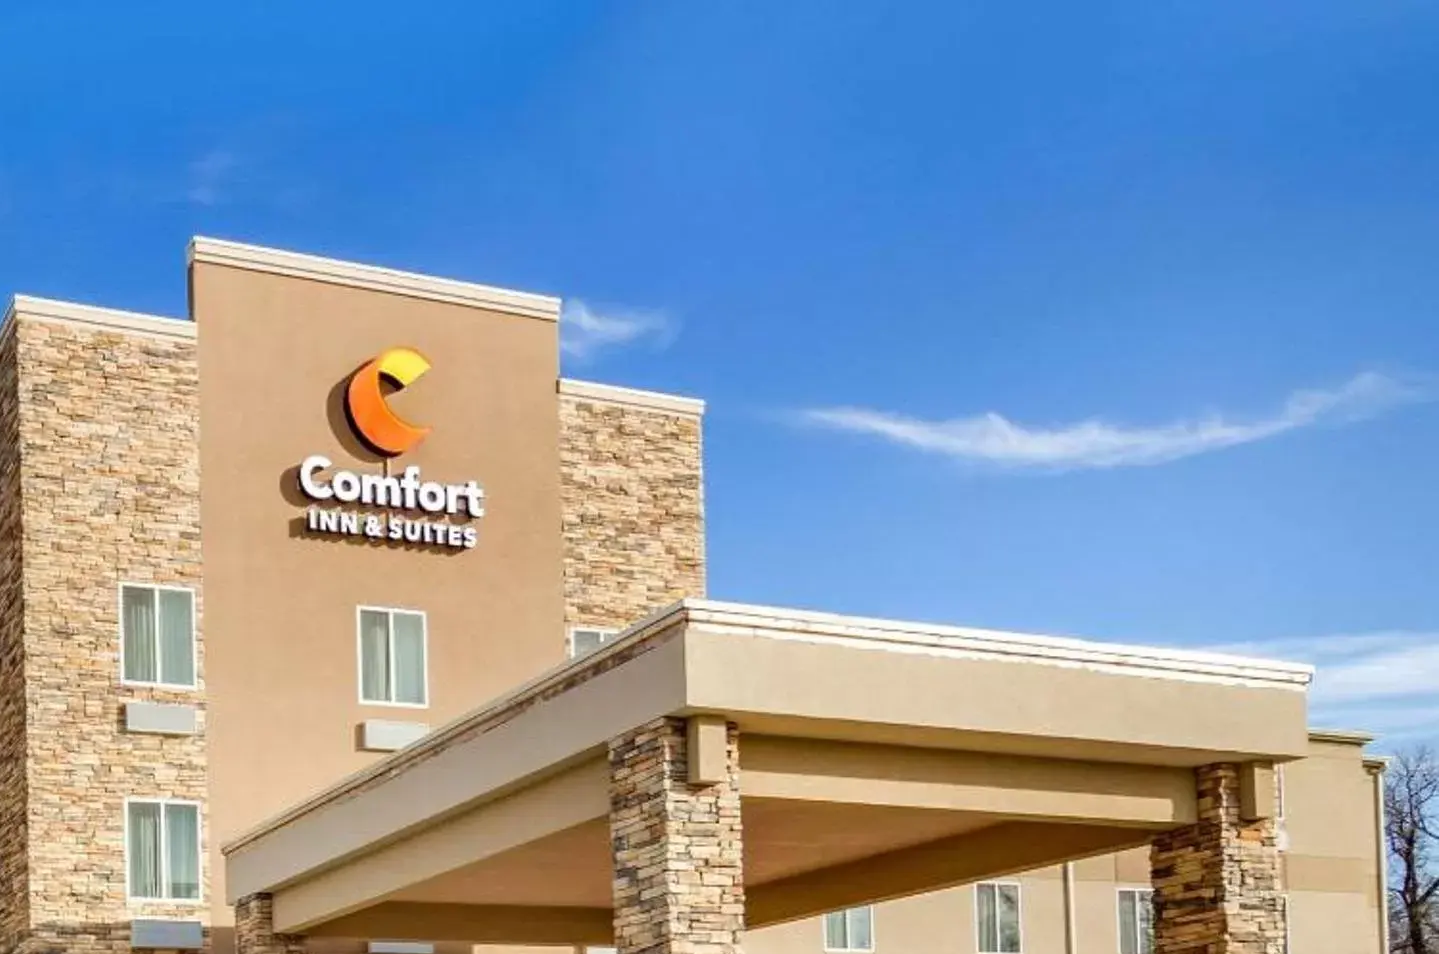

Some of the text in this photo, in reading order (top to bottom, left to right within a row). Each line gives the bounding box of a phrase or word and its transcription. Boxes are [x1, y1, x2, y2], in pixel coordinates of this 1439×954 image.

[299, 454, 484, 518] Comfort
[309, 509, 478, 549] INN & SUITES
